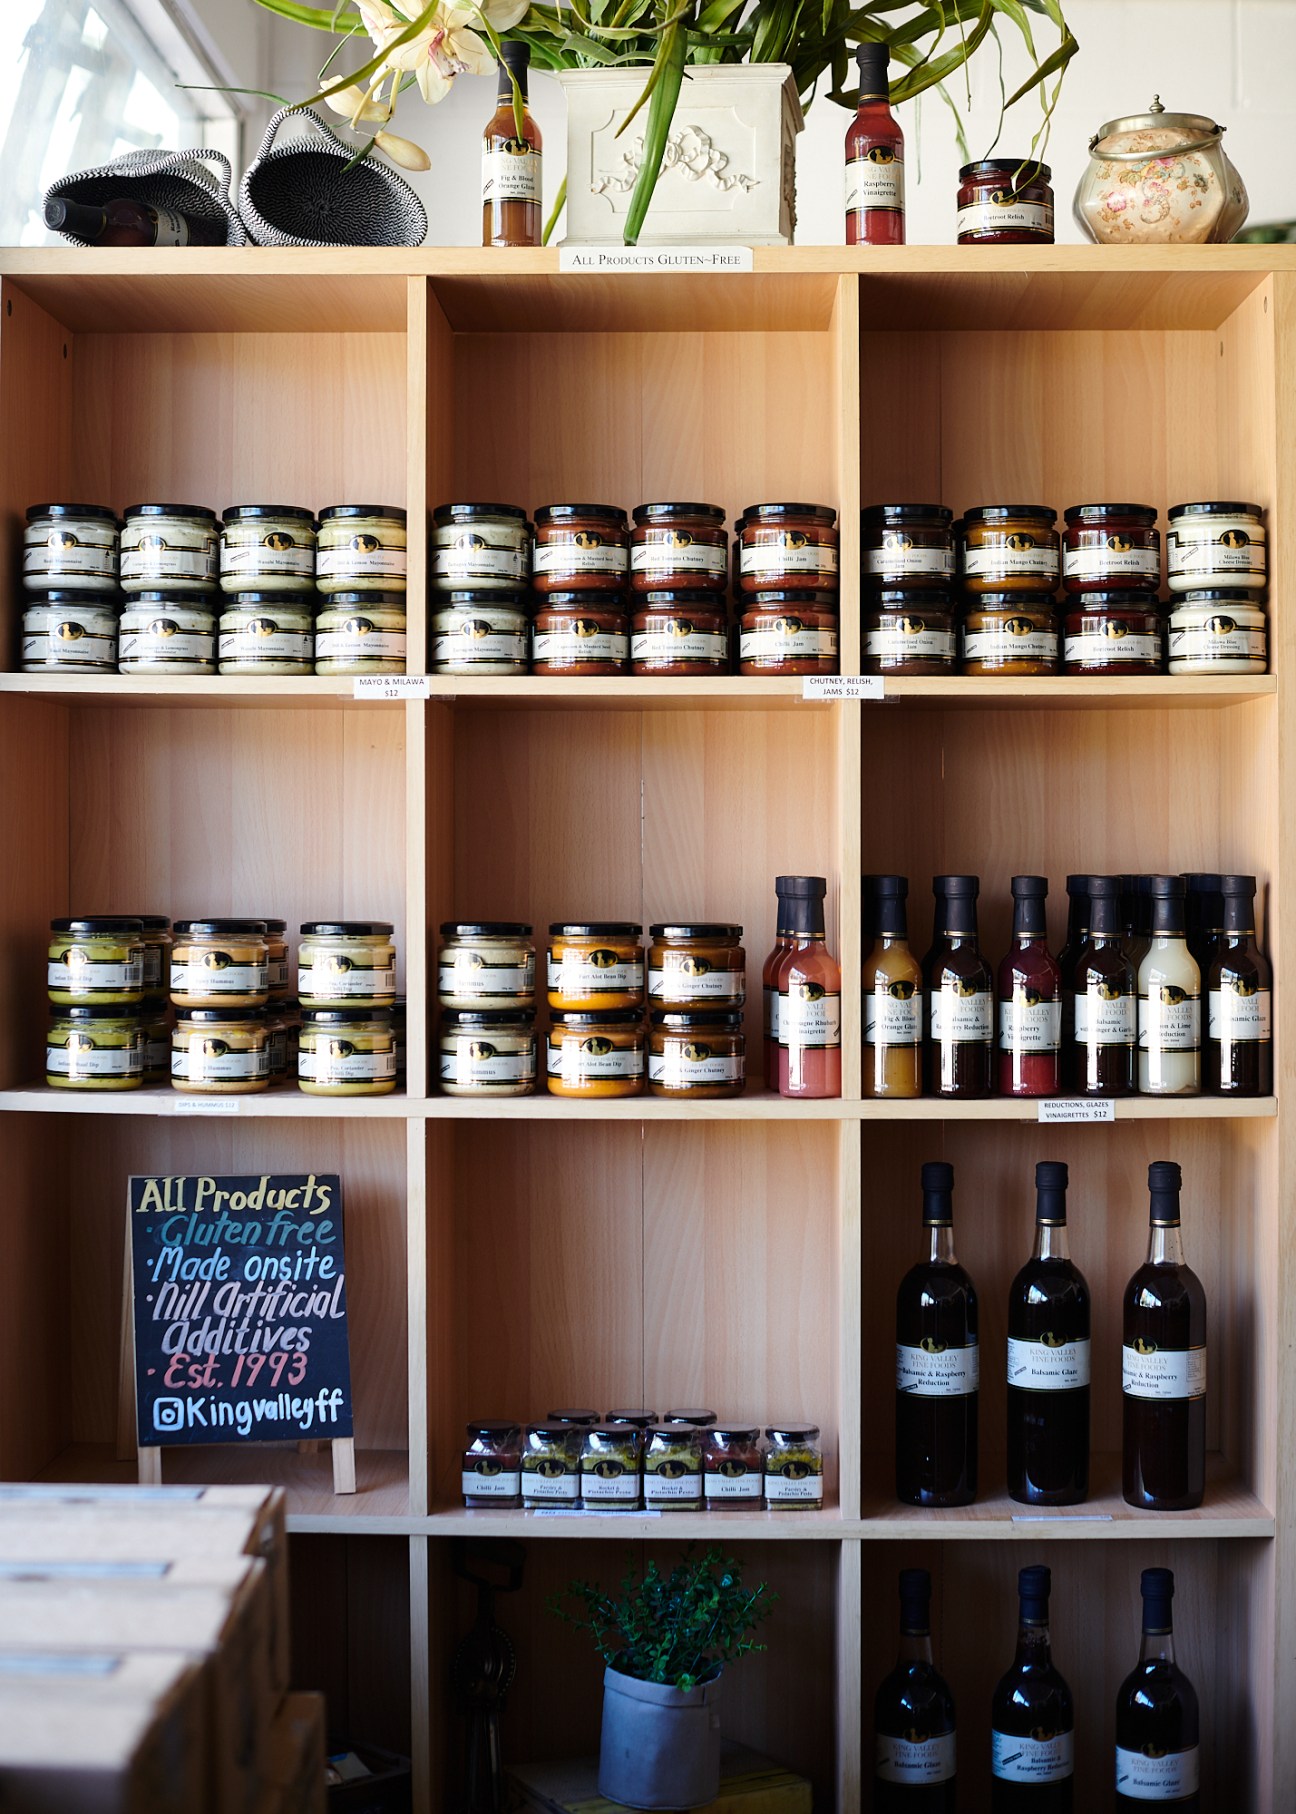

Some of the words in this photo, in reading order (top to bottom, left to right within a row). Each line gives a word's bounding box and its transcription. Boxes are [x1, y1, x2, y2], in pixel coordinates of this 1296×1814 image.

[572, 255, 594, 265] ALL
[599, 255, 654, 265] PRODUCTS
[136, 1177, 187, 1213] All
[195, 1175, 332, 1215] Products
[161, 1210, 262, 1246] Gluten
[266, 1210, 336, 1246] free
[151, 1246, 230, 1282] Made
[243, 1246, 337, 1281] onsite
[1051, 1348, 1076, 1356] VALLEY
[163, 1353, 223, 1389] Est.
[231, 1352, 308, 1388] 1993
[902, 1367, 926, 1376] Balsamic
[1145, 1373, 1177, 1381] Raspberry
[1131, 1380, 1159, 1388] Reduction
